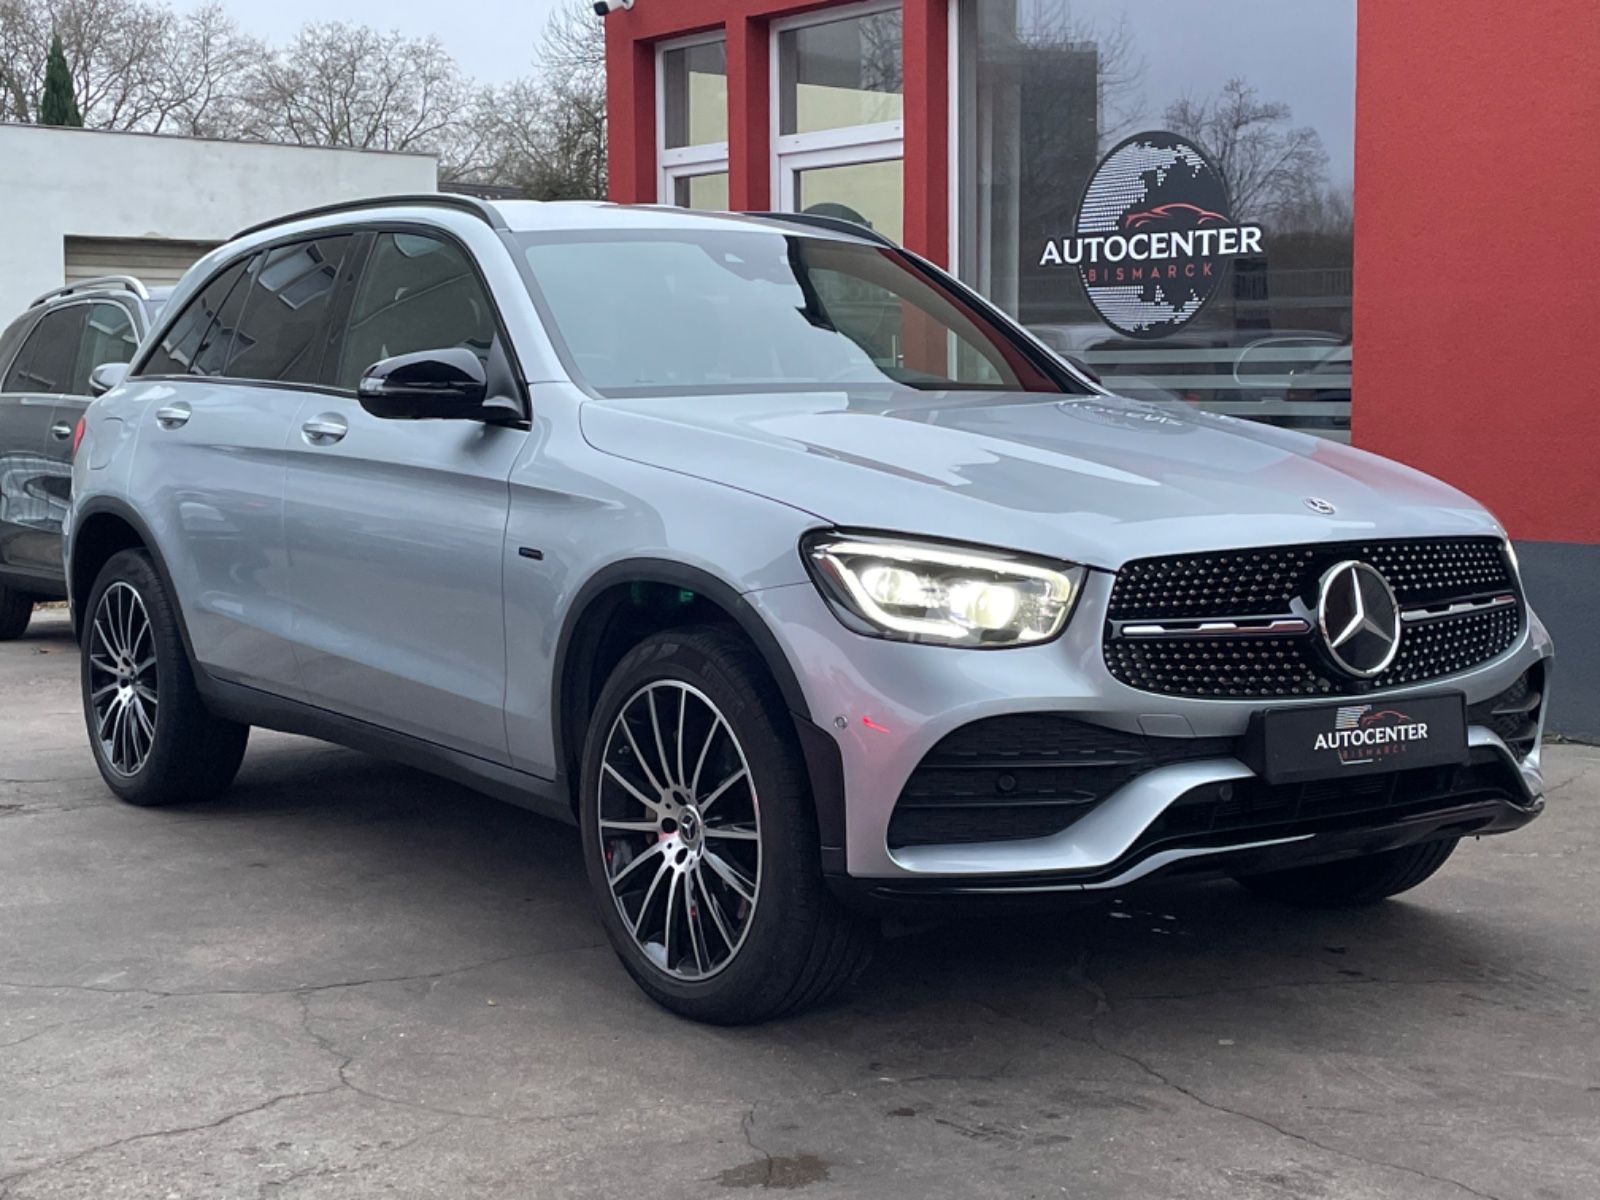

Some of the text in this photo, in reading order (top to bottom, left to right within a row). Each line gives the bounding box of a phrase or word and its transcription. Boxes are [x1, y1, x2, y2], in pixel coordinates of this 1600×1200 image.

[1040, 227, 1263, 265] AUTOCENTER
[1088, 263, 1213, 282] BISMARCK
[1314, 723, 1428, 750] AUTOCENTER
[1342, 744, 1407, 759] BISMARCK
